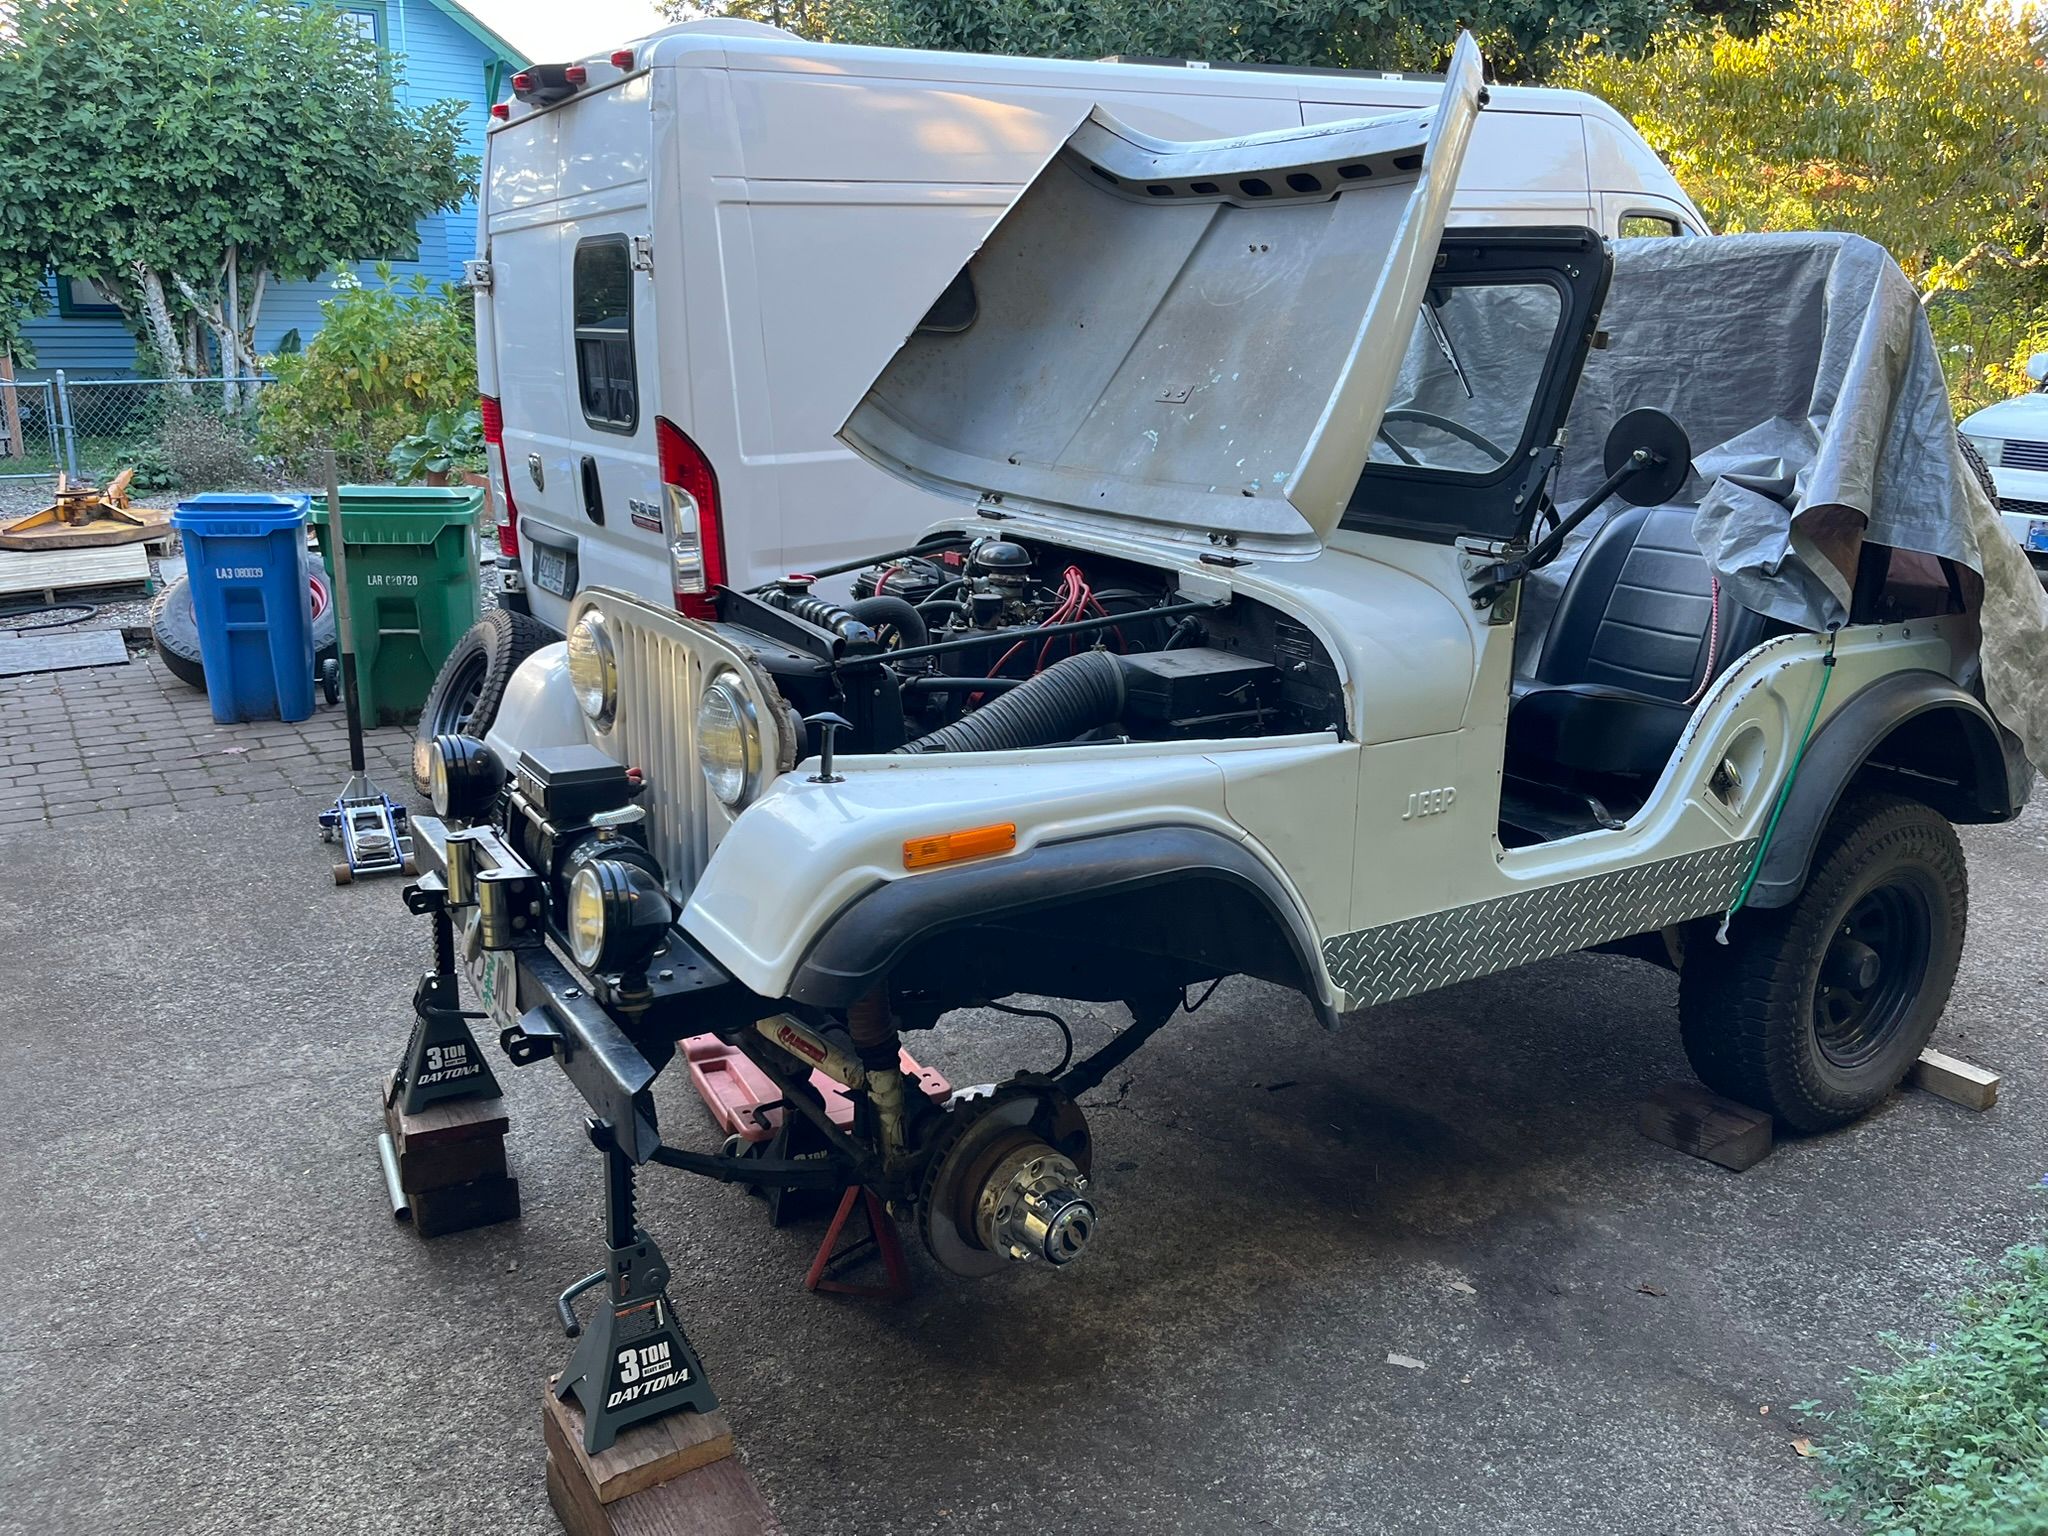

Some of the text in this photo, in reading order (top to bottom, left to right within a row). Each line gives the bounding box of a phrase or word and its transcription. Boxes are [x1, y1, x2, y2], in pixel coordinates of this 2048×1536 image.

[215, 567, 233, 579] LA3
[367, 574, 383, 586] LAR
[1401, 786, 1457, 821] JEEP
[426, 1046, 443, 1071] 3
[442, 1044, 466, 1060] TON
[417, 1063, 480, 1086] DAYTONA
[618, 1341, 671, 1384] 3 TON
[606, 1367, 689, 1409] DAYTONA
